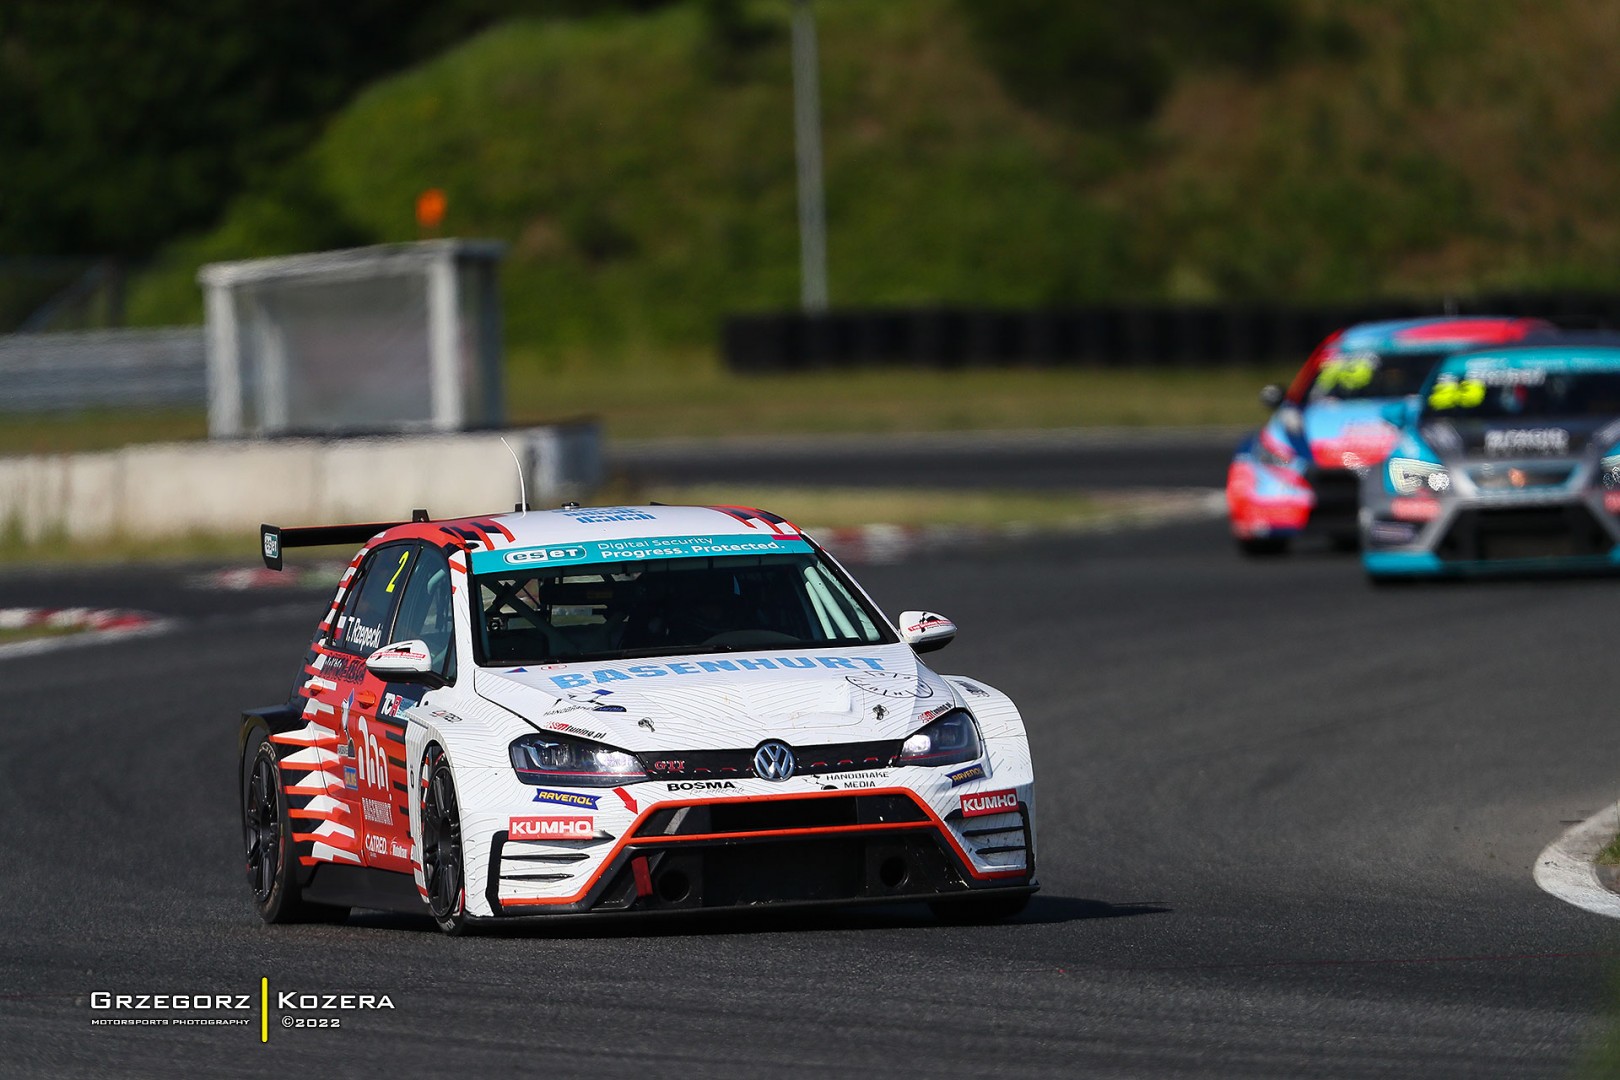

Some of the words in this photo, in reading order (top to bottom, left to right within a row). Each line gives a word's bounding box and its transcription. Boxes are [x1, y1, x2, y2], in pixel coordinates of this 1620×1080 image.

[597, 540, 649, 550] Digital
[652, 536, 714, 547] Security
[600, 546, 689, 559] Progress.
[692, 540, 786, 553] Protected.
[385, 551, 409, 593] 2
[345, 616, 355, 641] T.
[350, 618, 384, 651] Rzepecki
[549, 657, 886, 690] BASENHURT
[381, 692, 403, 718] TCR
[654, 759, 685, 770] GTI
[826, 771, 889, 781] HANDBRAKE
[666, 781, 736, 792] BOSMA
[844, 780, 876, 789] MEDIA
[539, 791, 596, 806] RAVENOL
[963, 793, 1018, 812] KUMHO
[512, 820, 593, 835] KUMHO
